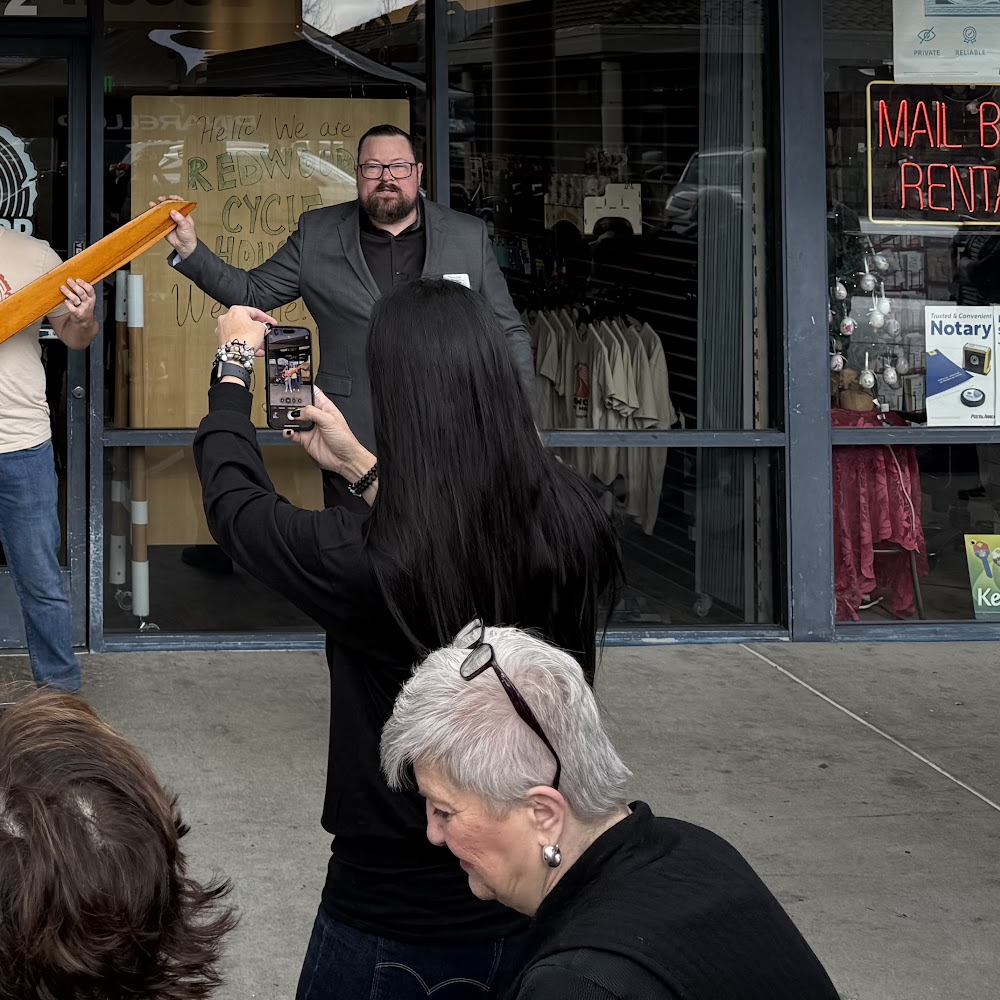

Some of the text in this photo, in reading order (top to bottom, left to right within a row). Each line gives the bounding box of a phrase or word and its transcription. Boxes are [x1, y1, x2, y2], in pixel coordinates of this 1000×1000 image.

[275, 114, 308, 141] We
[320, 121, 351, 138] are
[878, 99, 963, 148] MAIL
[930, 320, 992, 339] Notary
